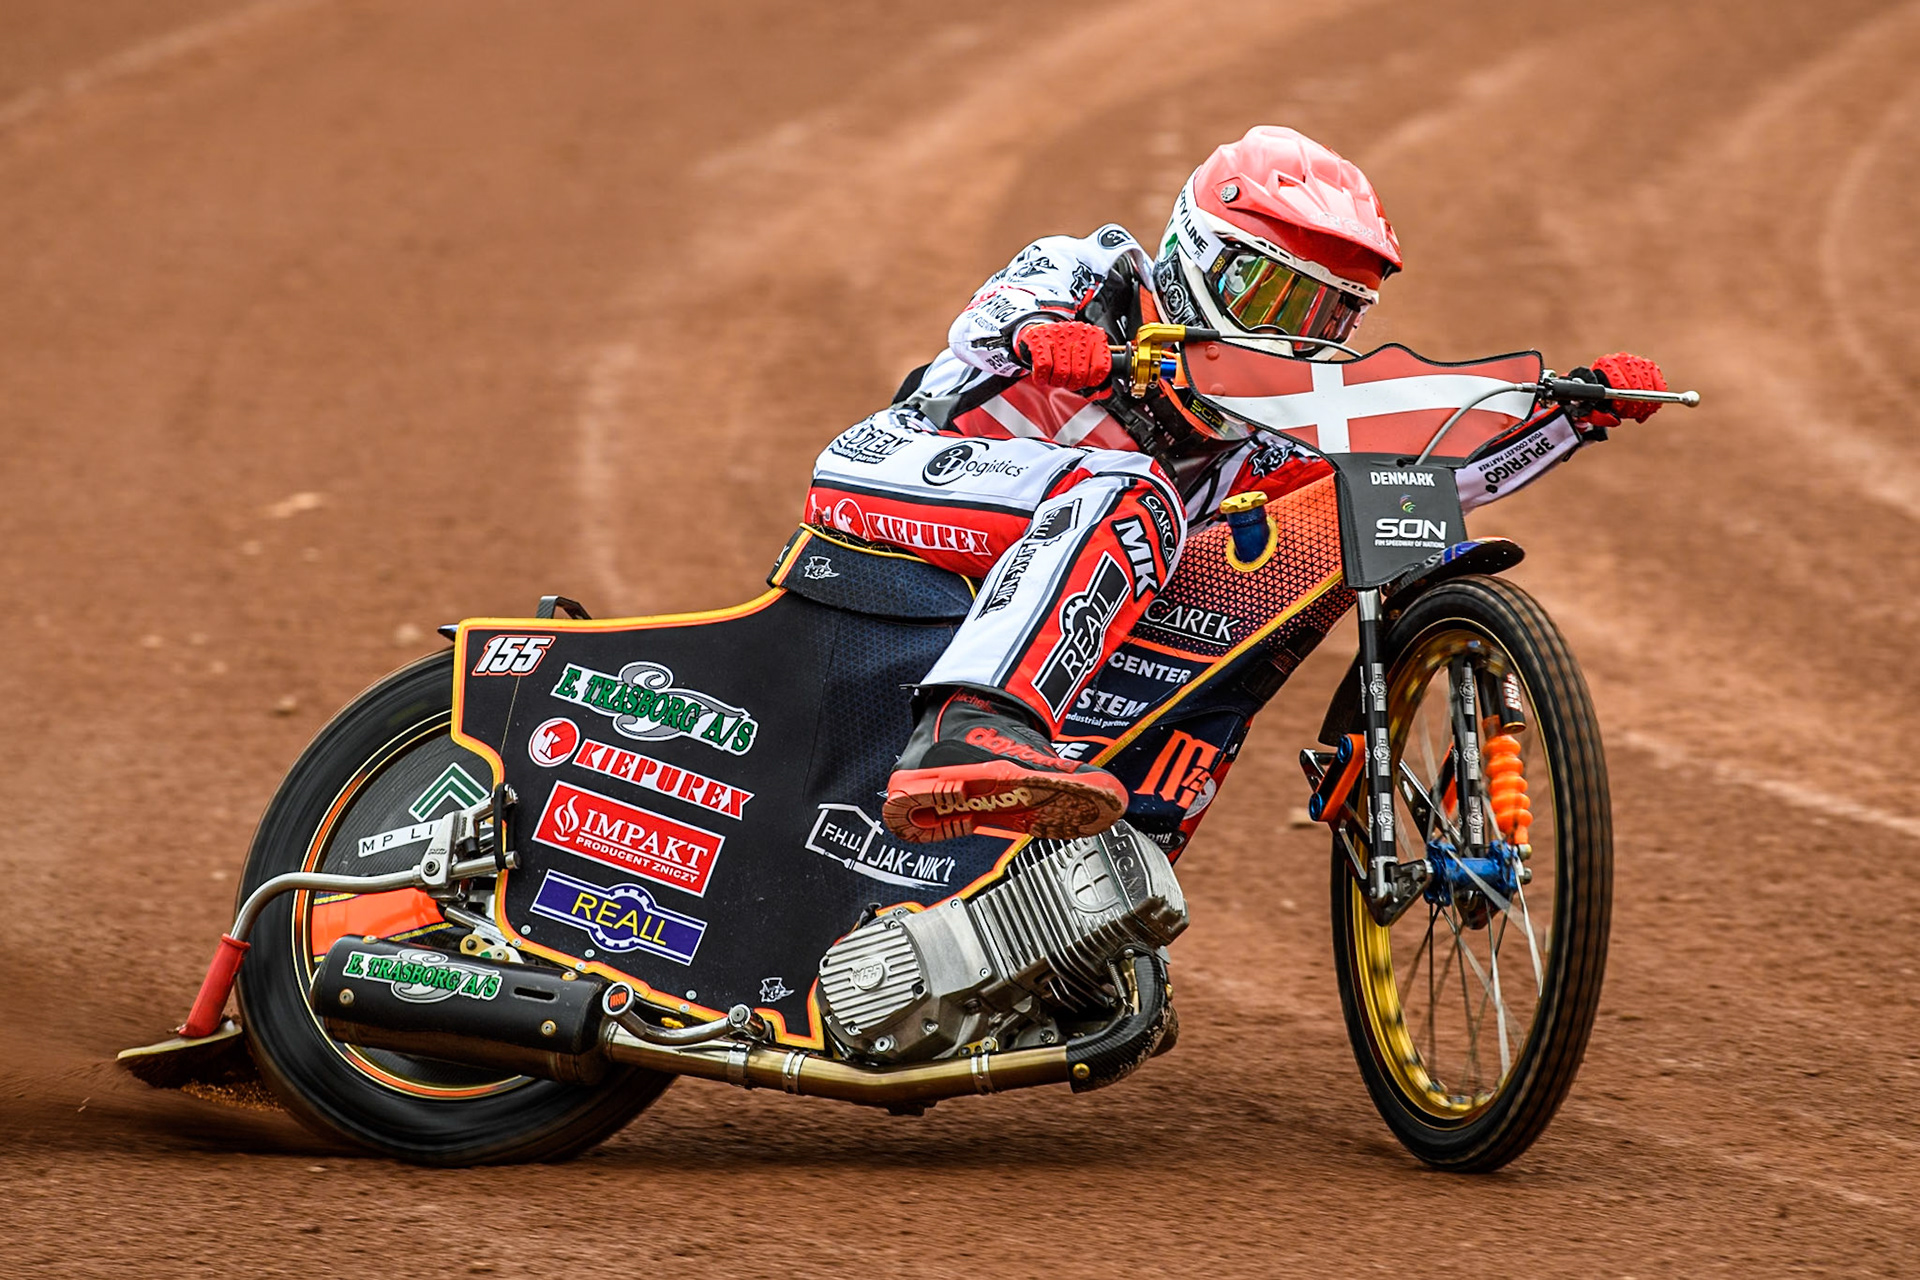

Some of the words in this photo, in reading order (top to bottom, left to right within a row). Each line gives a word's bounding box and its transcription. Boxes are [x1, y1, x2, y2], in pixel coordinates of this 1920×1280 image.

[1185, 219, 1209, 254] LINE
[1478, 456, 1504, 472] PARTNER
[1484, 437, 1555, 484] 3PLFRIGO
[1504, 441, 1528, 458] COOLEST
[1370, 472, 1435, 487] DENMARK
[867, 513, 991, 556] KIEPUREX
[1146, 496, 1176, 564] GARCA
[1375, 518, 1446, 540] SON
[1114, 519, 1157, 598] MK
[1061, 592, 1115, 680] REALL
[1144, 599, 1241, 642] CAREK
[474, 636, 554, 675] 155
[1108, 651, 1192, 685] CENTER
[556, 668, 581, 697] E.
[582, 674, 700, 733] TRASBORG
[703, 712, 755, 752] A/S
[1065, 712, 1102, 726] ndustrial
[1076, 687, 1149, 718] STEM
[574, 740, 754, 818] KIEPUREX
[581, 809, 708, 869] IMPAKT
[821, 822, 861, 852] F.H.U.
[576, 836, 650, 870] PRODUCENT
[652, 863, 698, 884] ZNICZY
[571, 892, 667, 946] REALL
[346, 954, 364, 975] E.
[368, 958, 461, 990] TRASBORG
[461, 974, 500, 997] A/S
